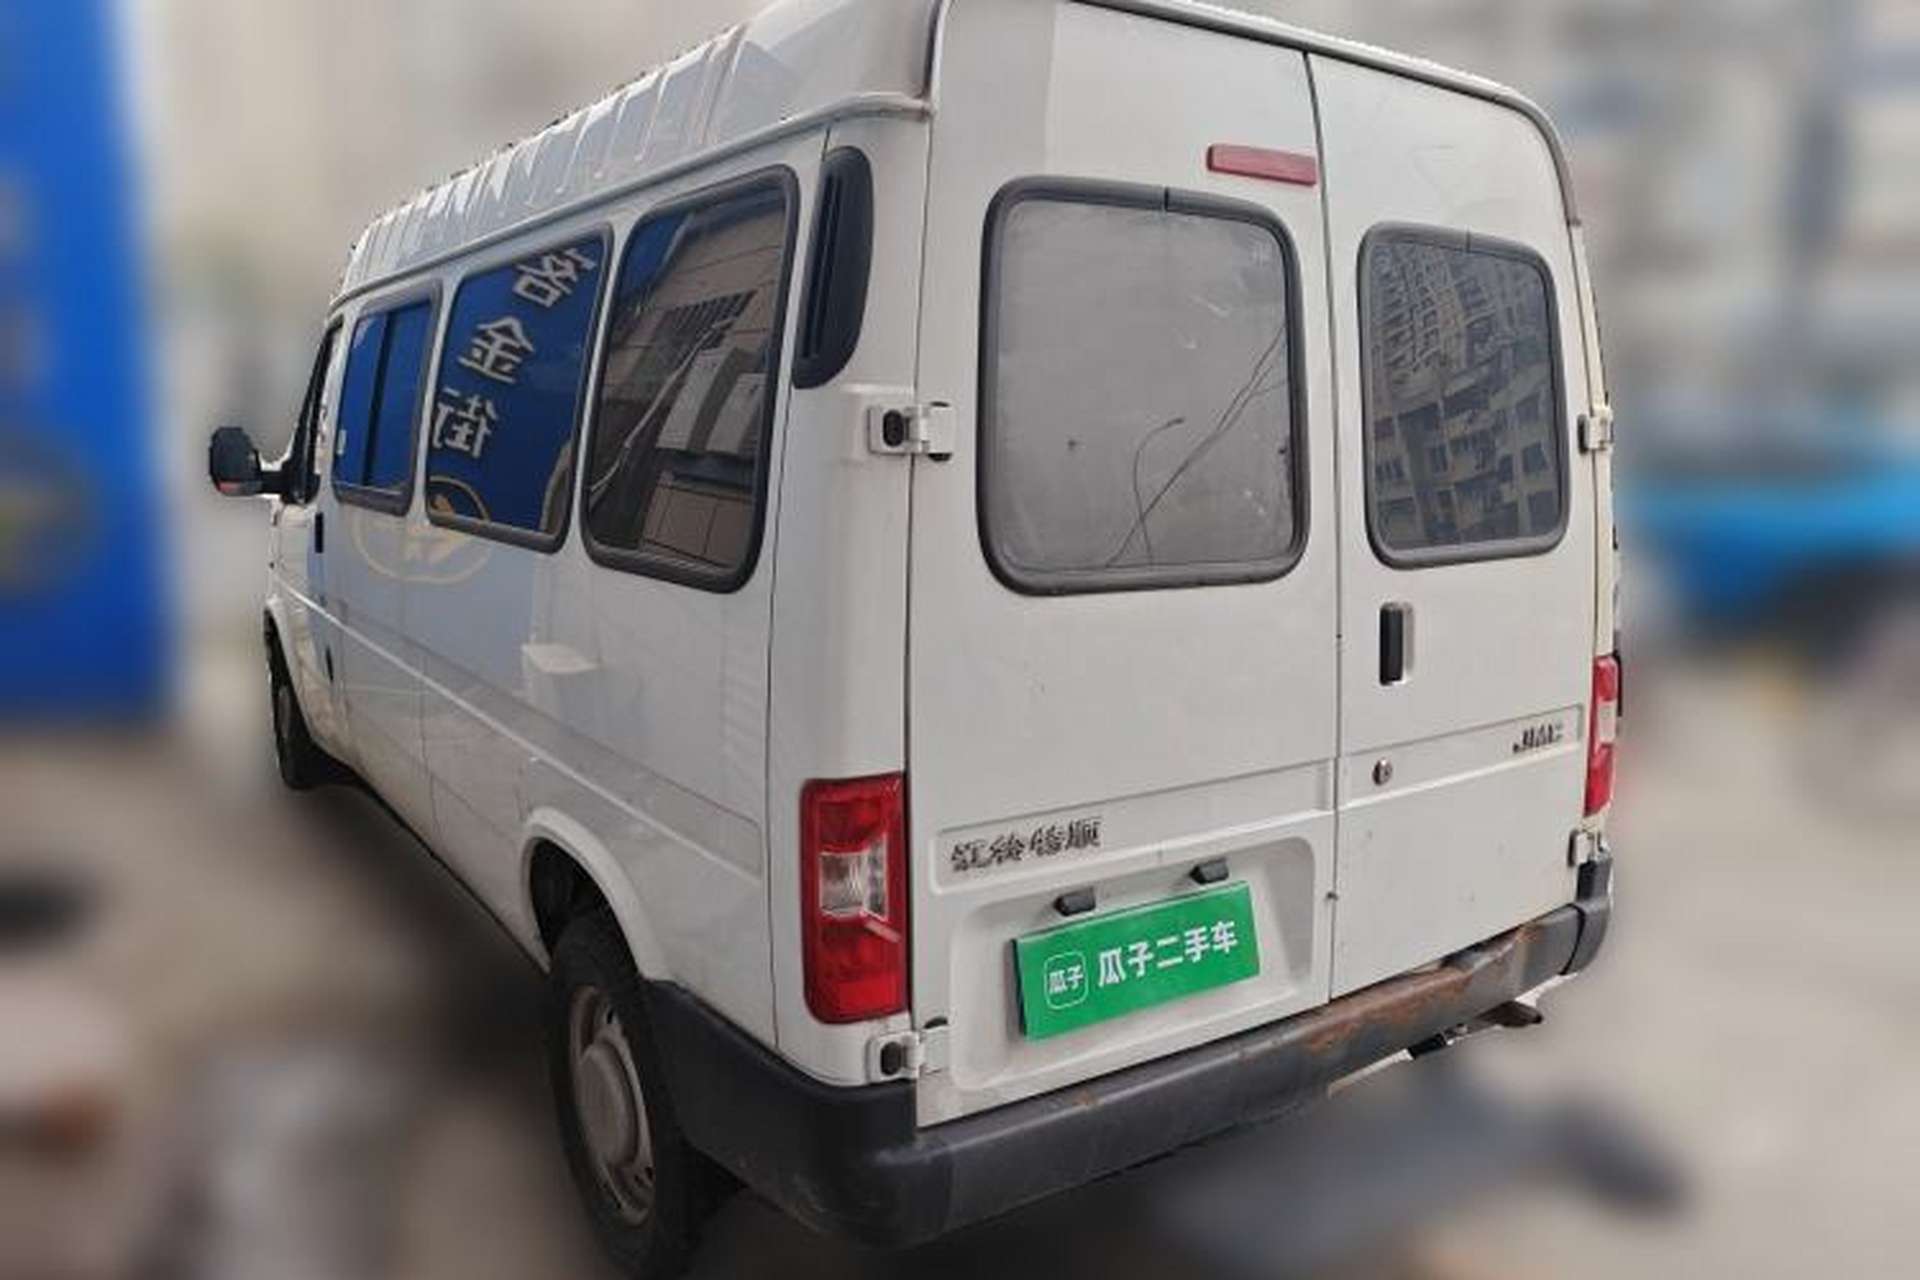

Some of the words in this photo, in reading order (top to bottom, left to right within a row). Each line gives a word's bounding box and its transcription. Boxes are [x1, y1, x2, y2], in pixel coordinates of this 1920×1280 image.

[1098, 920, 1239, 988] 瓜子二手车
[1048, 964, 1085, 995] 瓜子
